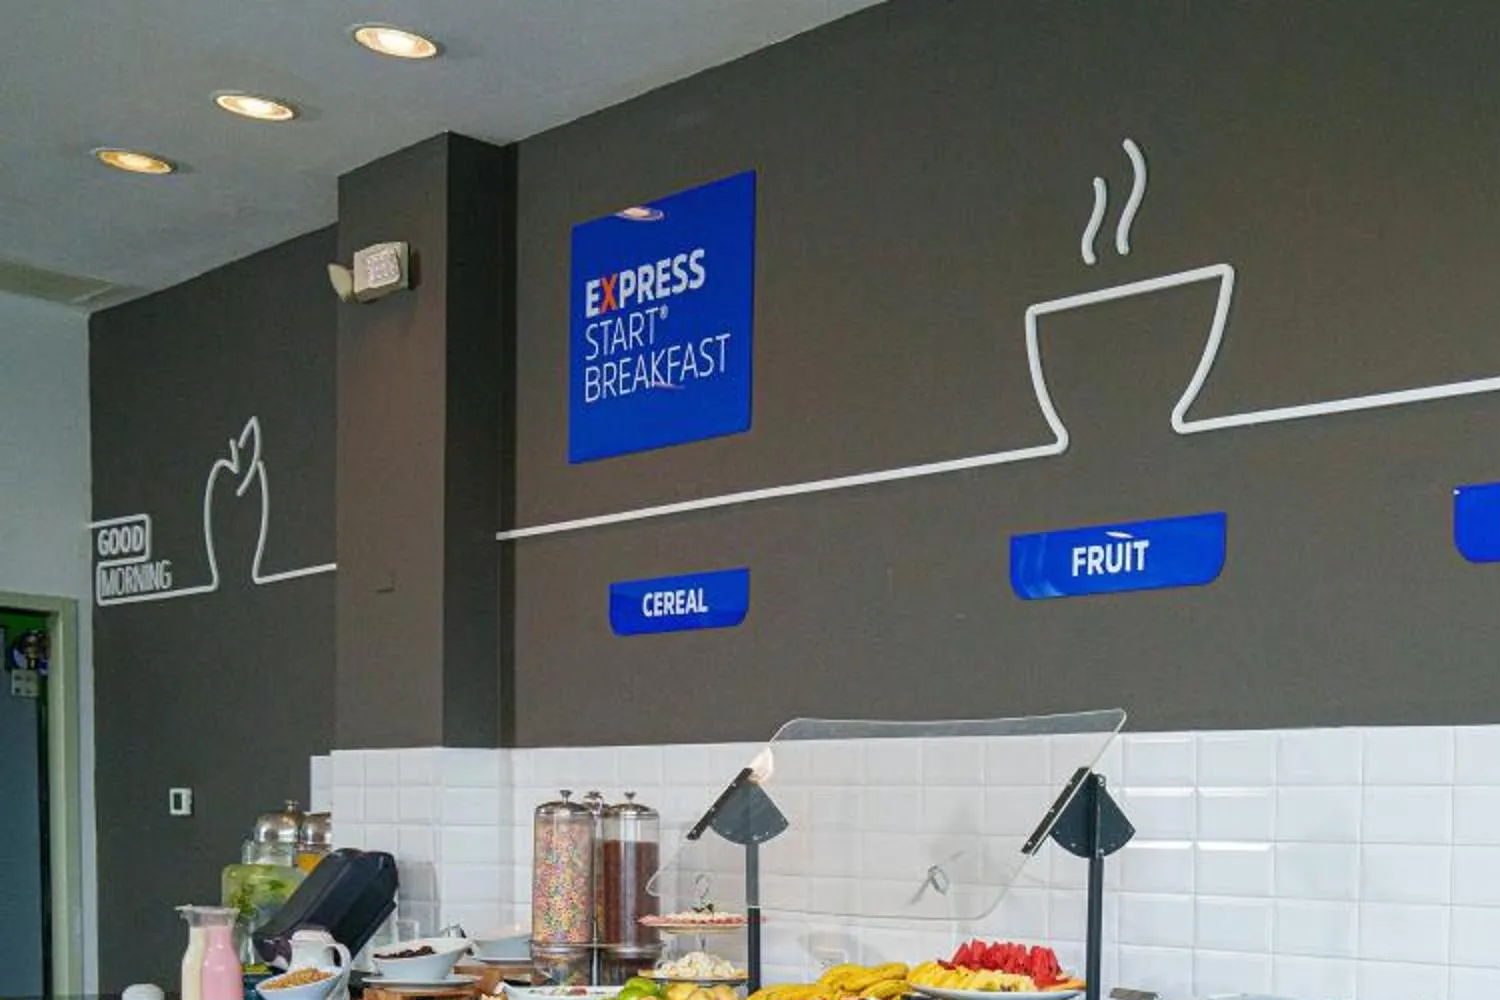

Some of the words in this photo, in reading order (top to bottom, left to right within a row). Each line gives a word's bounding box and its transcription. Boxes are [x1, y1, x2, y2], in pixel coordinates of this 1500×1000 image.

[585, 248, 706, 318] EXPRESS
[585, 333, 731, 403] BREAKFAST
[98, 525, 144, 556] GOOD
[1071, 539, 1149, 577] FRUIT
[101, 559, 172, 597] MORNING
[642, 587, 709, 617] CEREAL
